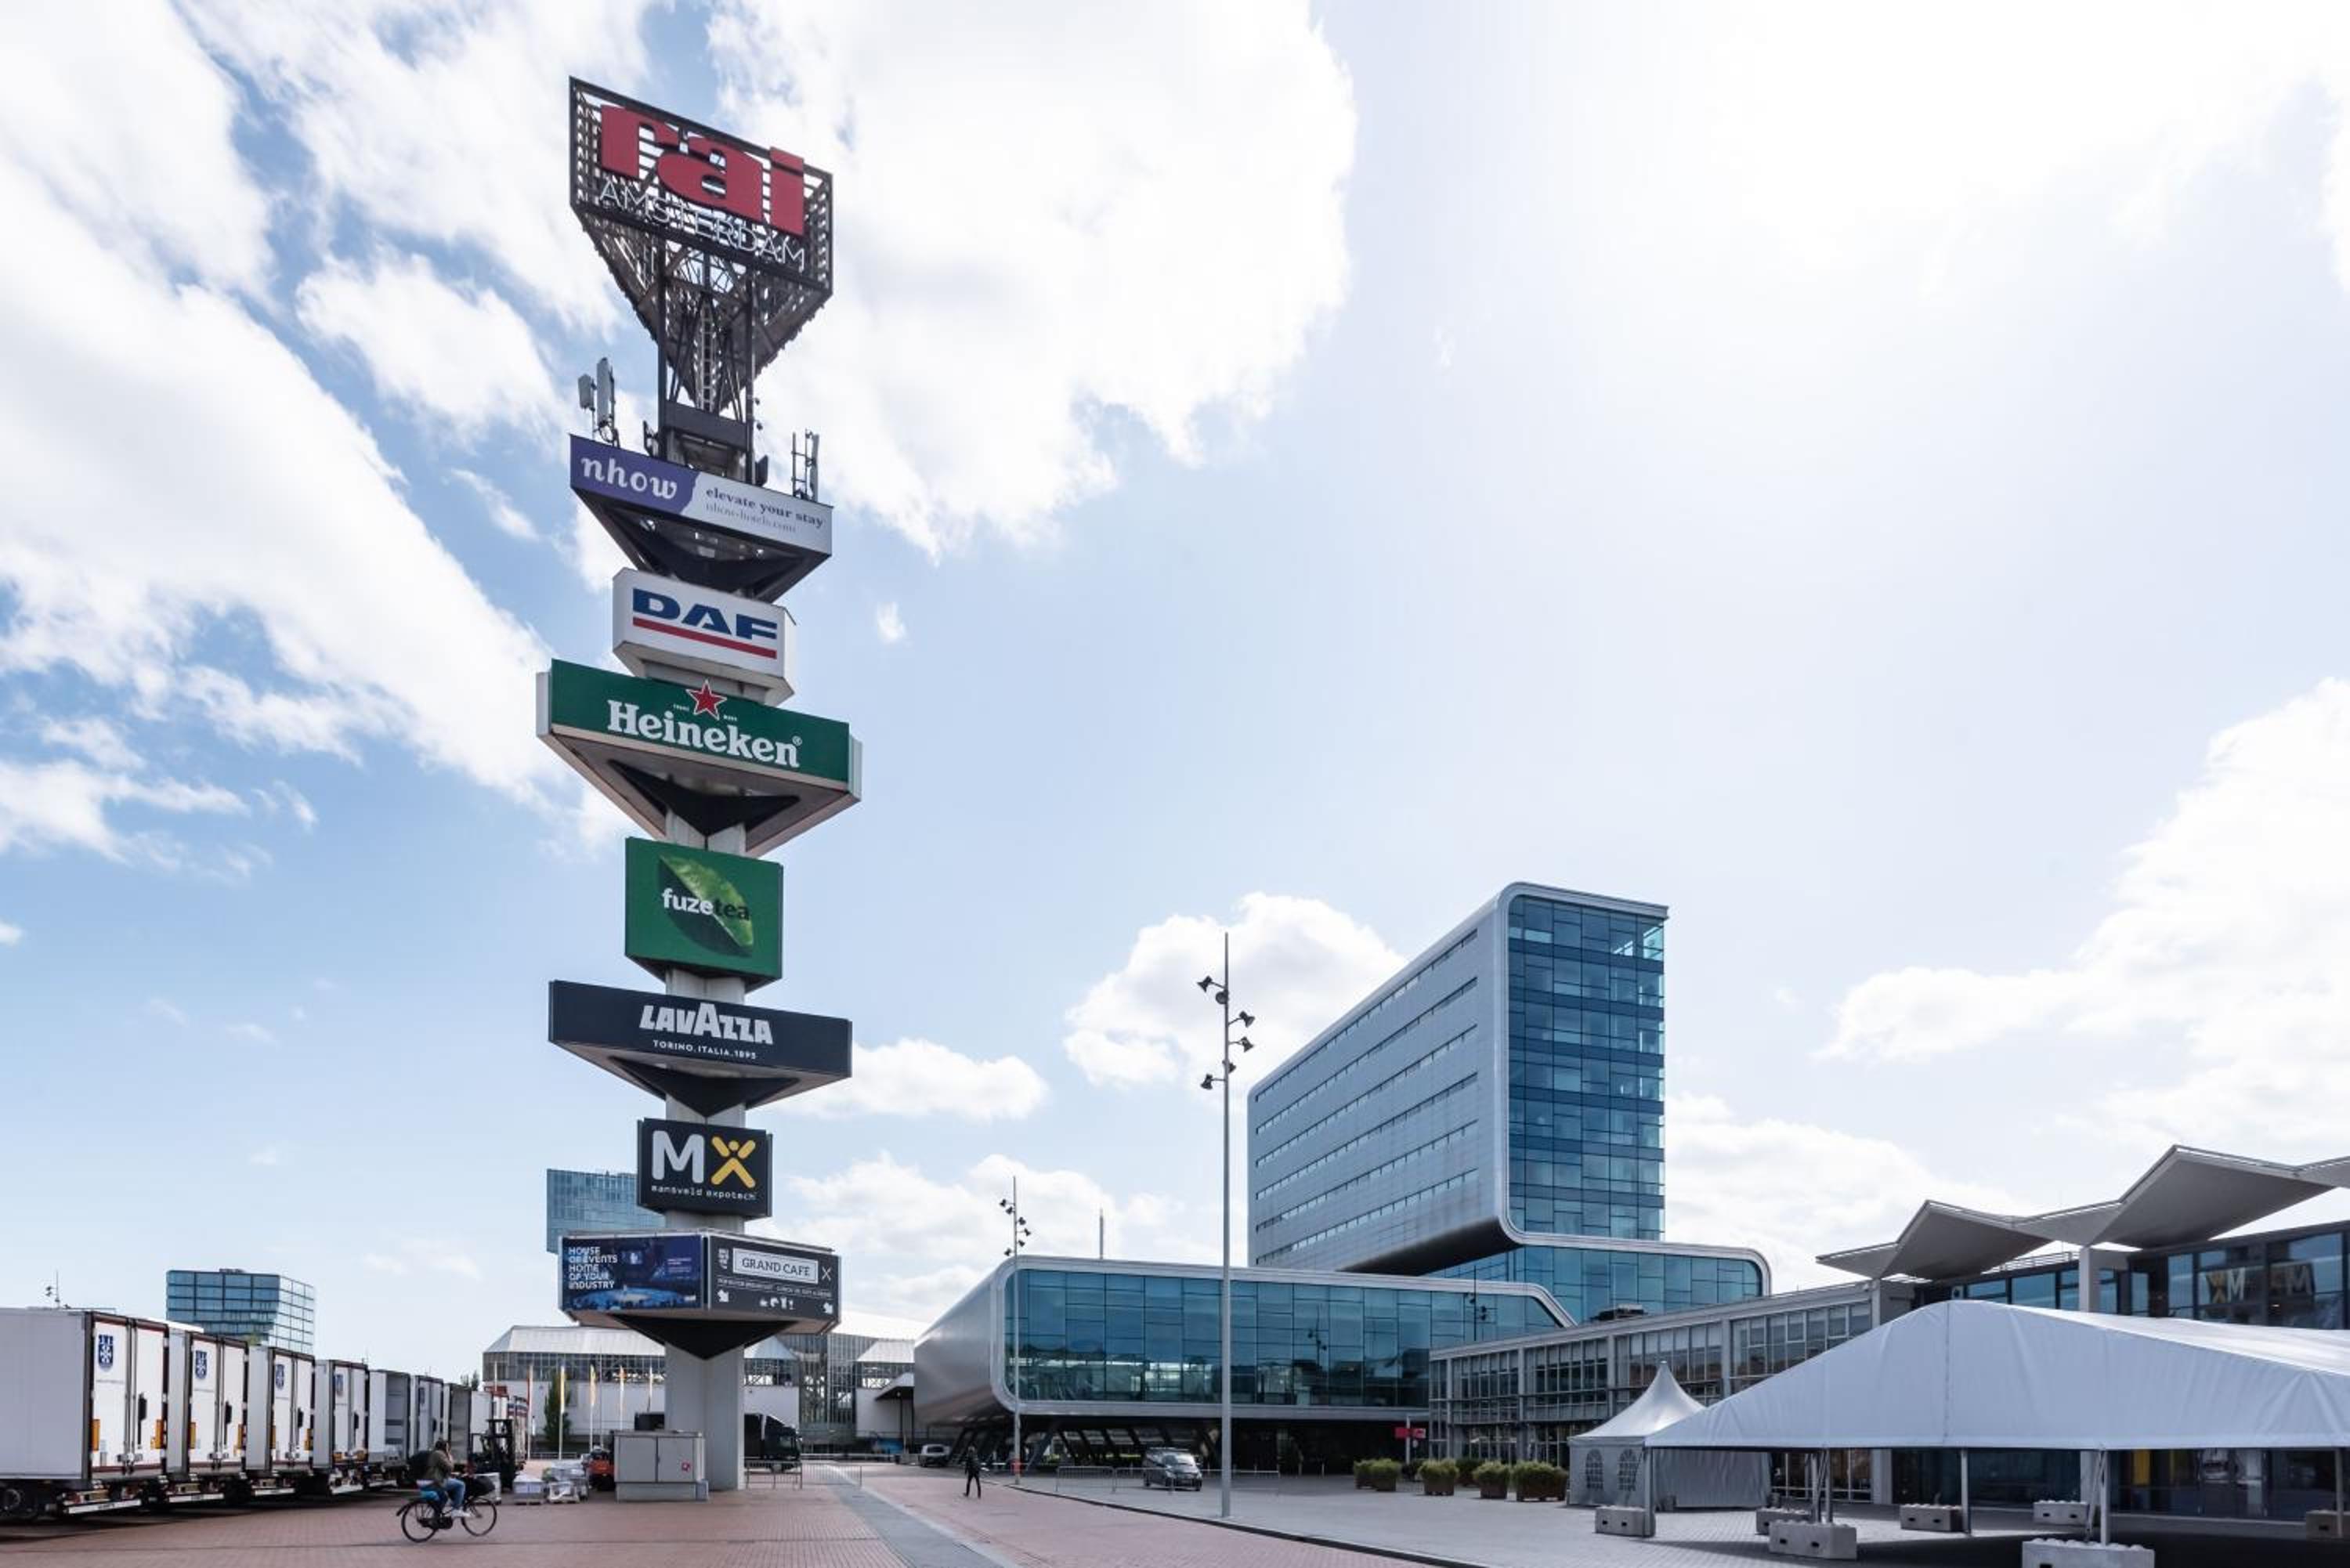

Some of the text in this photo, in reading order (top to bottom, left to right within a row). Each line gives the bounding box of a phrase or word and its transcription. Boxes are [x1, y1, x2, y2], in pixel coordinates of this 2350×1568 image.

[598, 179, 804, 273] AMSTERDAM
[580, 457, 677, 499] nhow
[706, 487, 823, 529] elevate your stay
[633, 588, 777, 640] DAF
[639, 1003, 774, 1045] LAVAZZA
[652, 1130, 756, 1189] MX
[742, 1257, 781, 1272] GRAND
